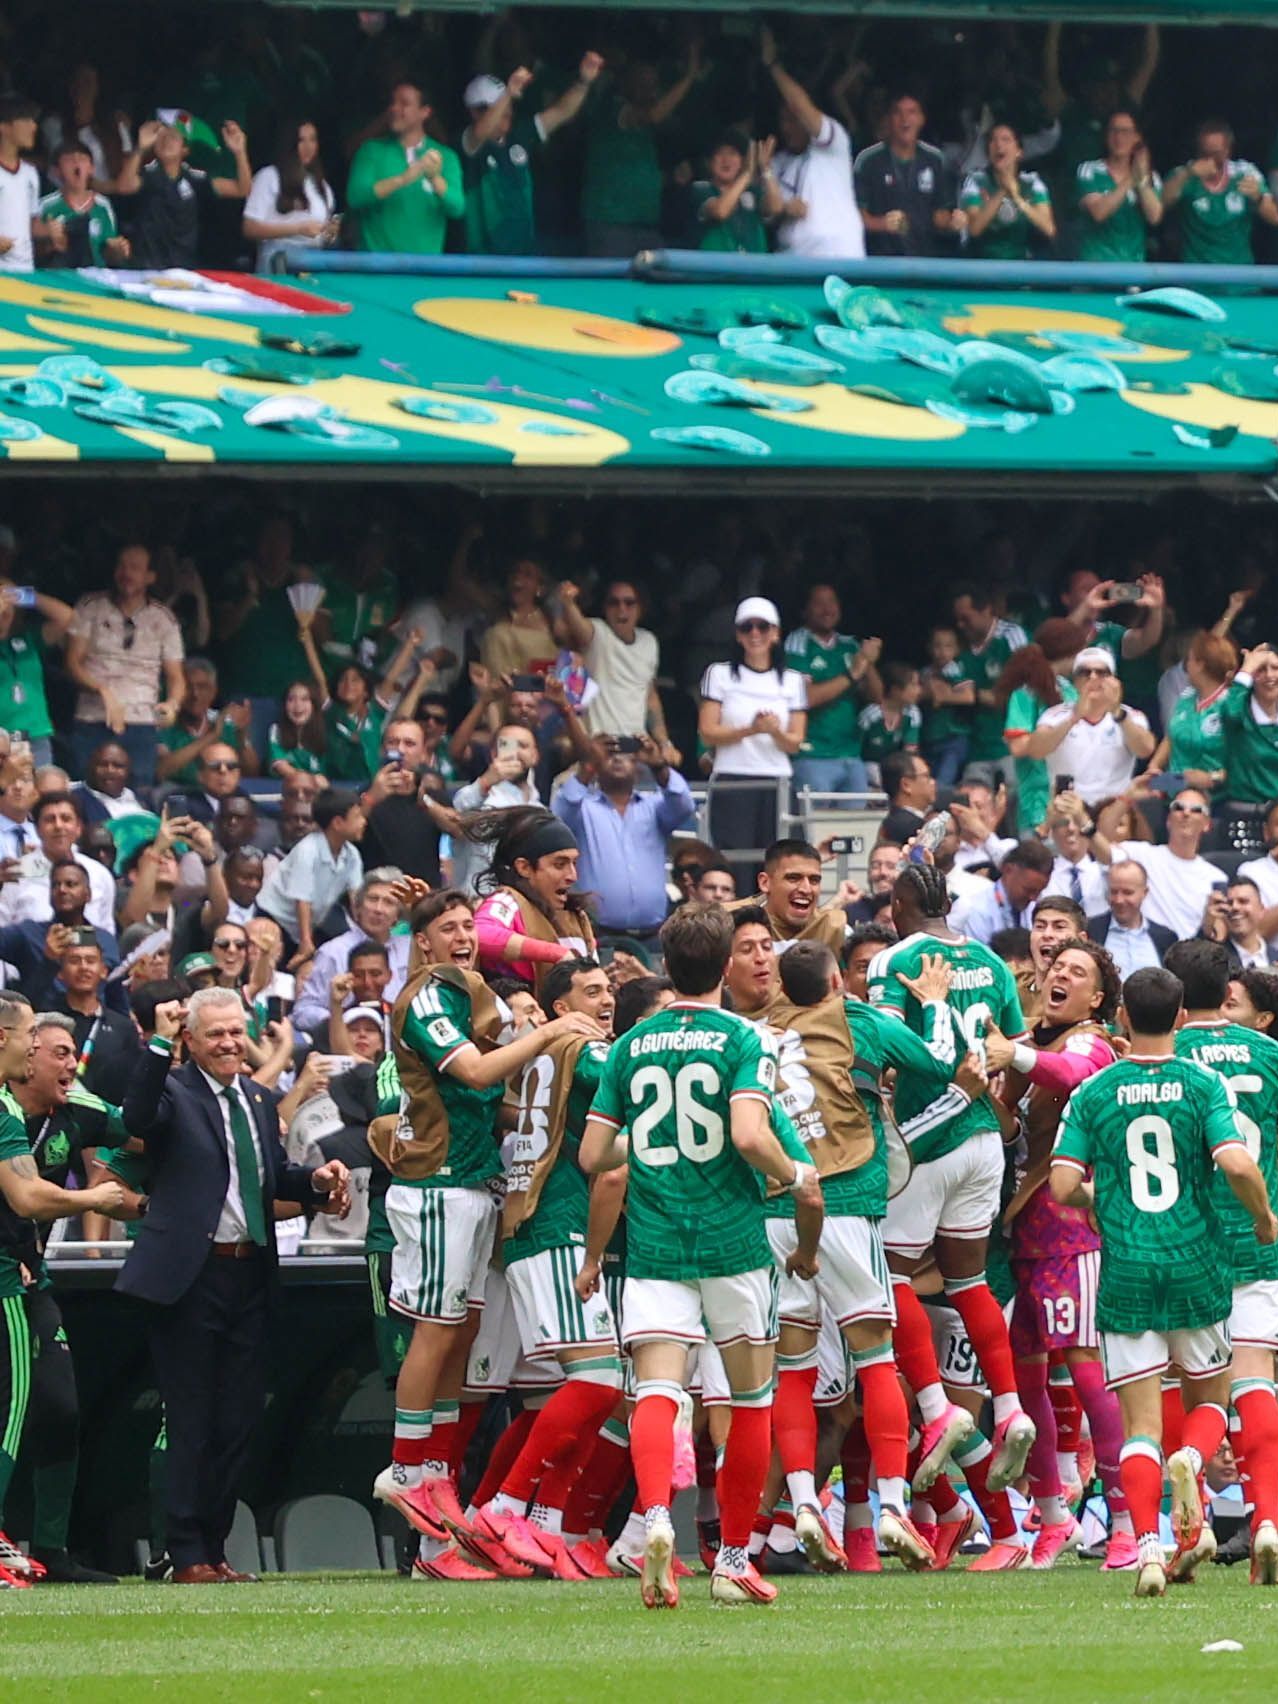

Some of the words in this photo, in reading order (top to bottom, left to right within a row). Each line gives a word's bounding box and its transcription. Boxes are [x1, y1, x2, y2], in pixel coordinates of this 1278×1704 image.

[630, 1026, 728, 1058] B.GUTIÉRREZ
[1117, 1082, 1183, 1106] FIDALGO
[630, 1062, 724, 1166] 26
[1126, 1115, 1180, 1213] 8
[1043, 1296, 1076, 1335] 13
[945, 1335, 973, 1373] 19
